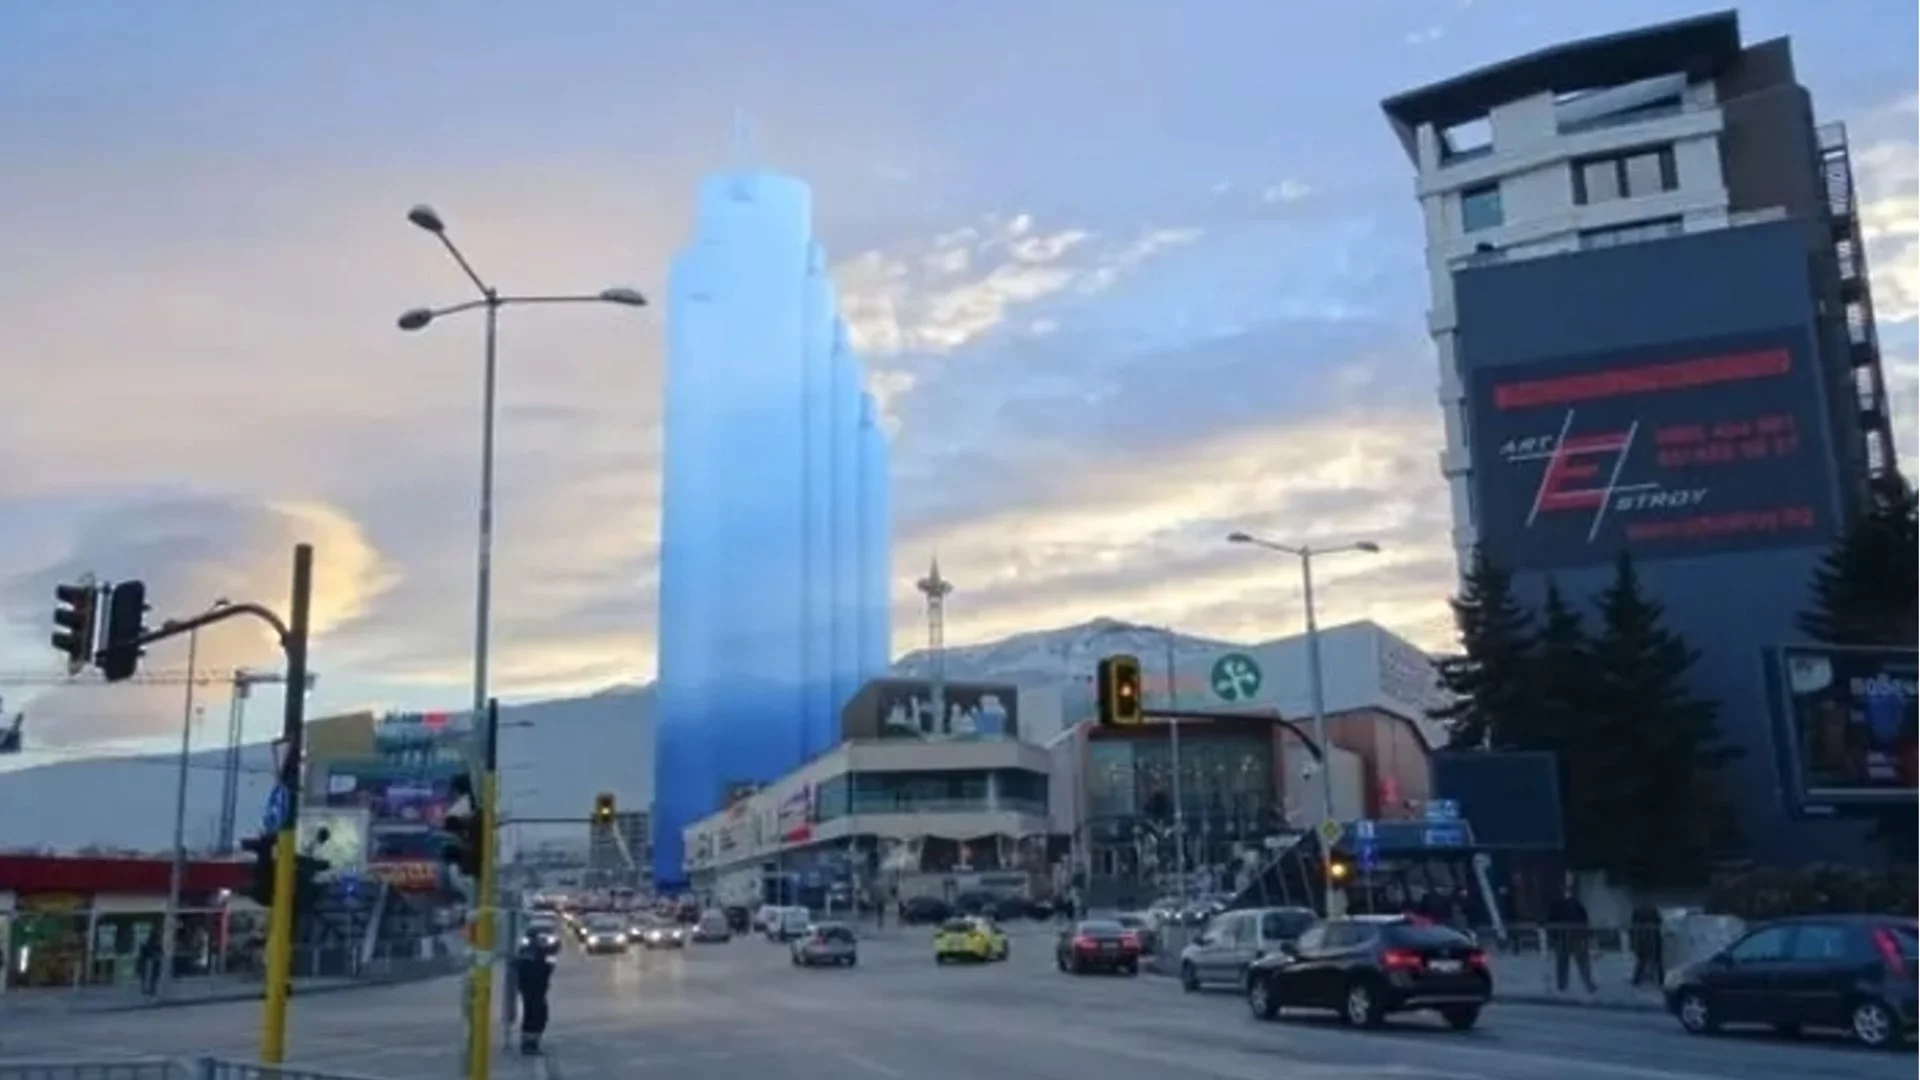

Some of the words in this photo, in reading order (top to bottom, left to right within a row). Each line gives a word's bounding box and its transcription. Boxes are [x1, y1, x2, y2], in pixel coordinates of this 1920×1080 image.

[1500, 436, 1553, 454] ART
[1538, 432, 1631, 511] E
[1615, 487, 1708, 511] STROY
